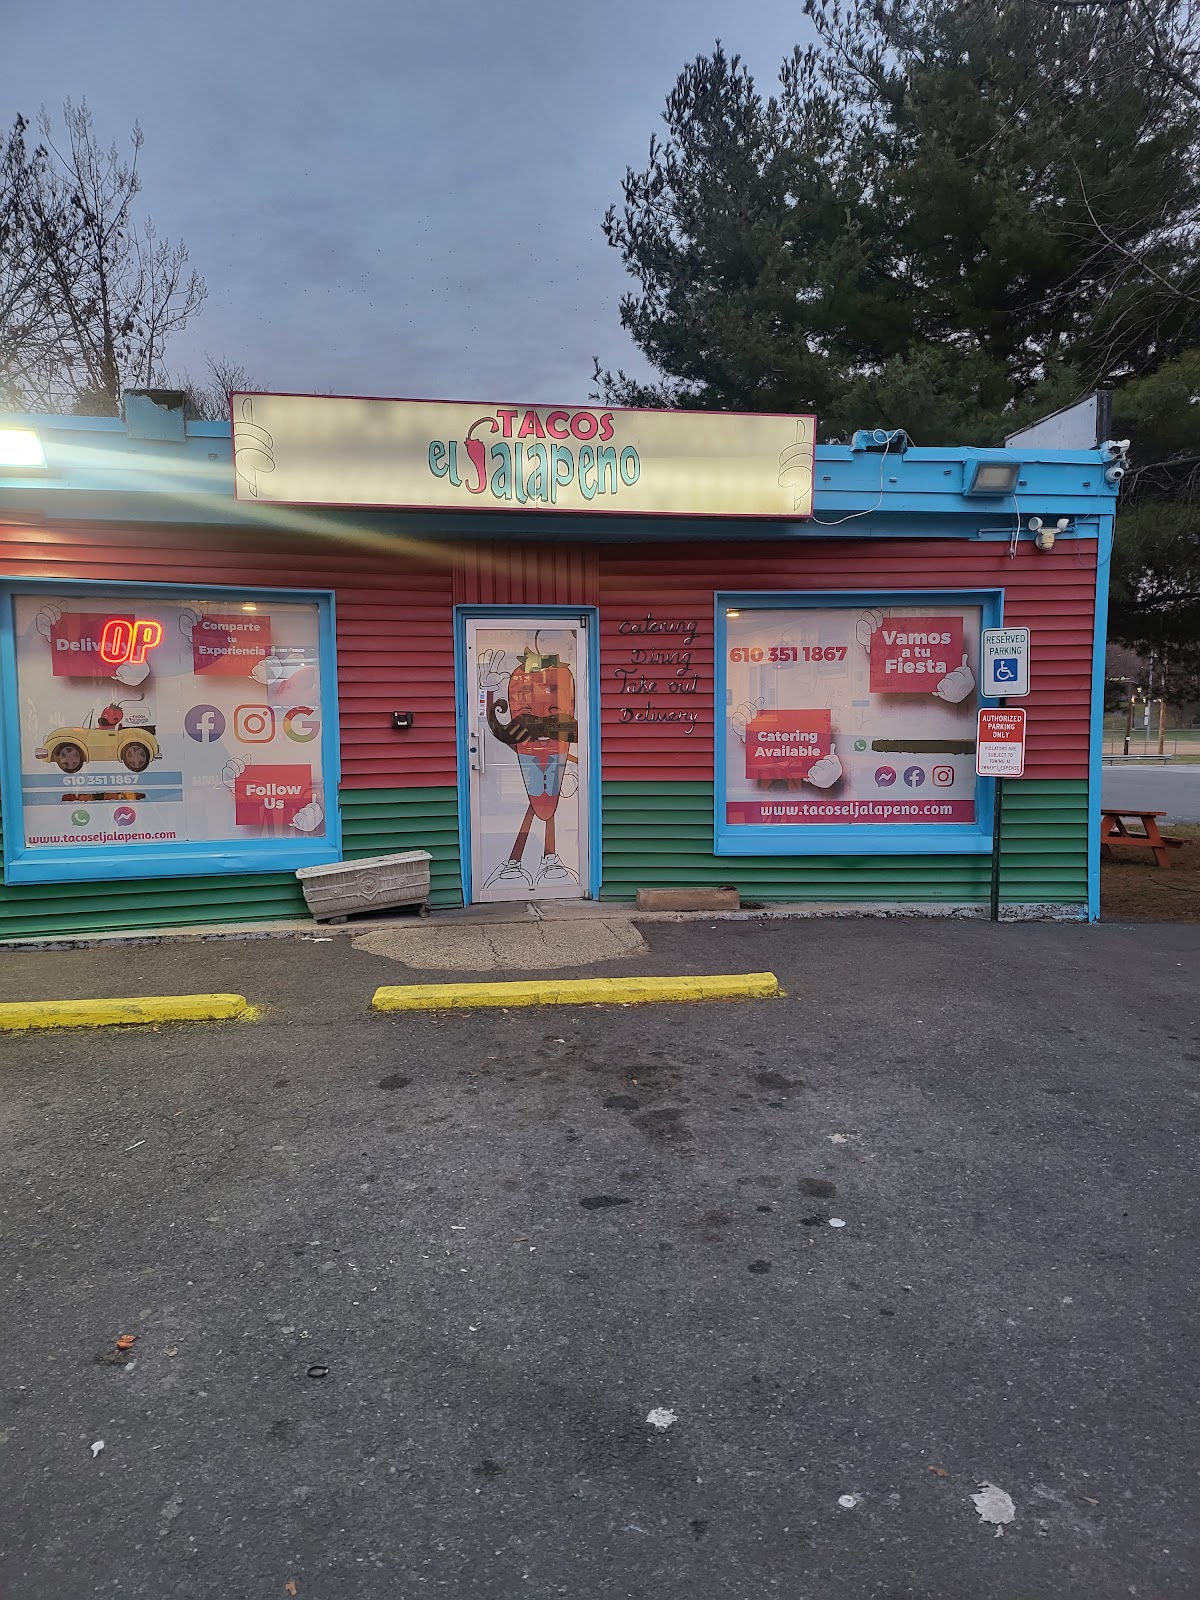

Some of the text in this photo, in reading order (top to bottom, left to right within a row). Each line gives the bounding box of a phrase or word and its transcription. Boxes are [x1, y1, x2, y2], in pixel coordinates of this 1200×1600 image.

[496, 409, 614, 441] TACOS
[428, 440, 462, 488] el
[202, 621, 261, 632] Comparte
[882, 630, 952, 645] Vamos
[986, 635, 1026, 644] RESERVED
[198, 645, 265, 657] Experiencia
[729, 646, 848, 662] 610 351 1867
[902, 646, 931, 658] a tu
[989, 646, 1022, 656] PARKING
[630, 647, 692, 676] Dining
[885, 657, 947, 674] Fiesta
[614, 668, 701, 694] Take out
[618, 701, 698, 734] Delivery
[757, 730, 818, 743] Catering
[754, 745, 821, 757] Available
[62, 774, 139, 786] 610 351 1867
[245, 783, 301, 796] Follow
[263, 797, 284, 809] Us
[760, 802, 952, 818] www.tacoseljalapeno.com
[28, 831, 176, 844] www.tacoseljalapeno.com
